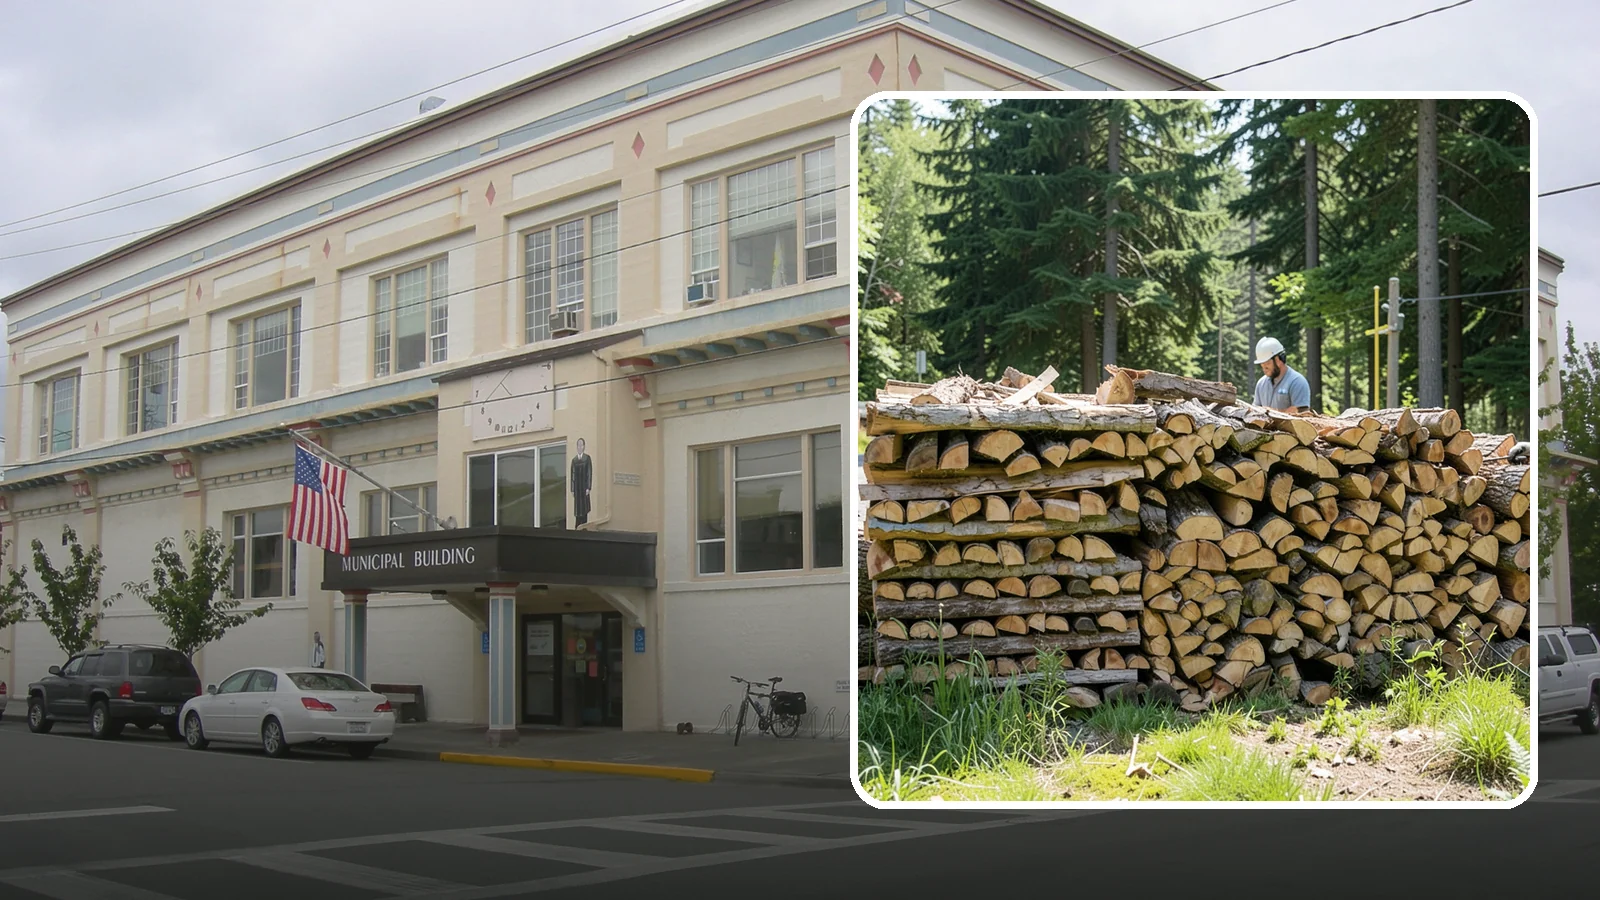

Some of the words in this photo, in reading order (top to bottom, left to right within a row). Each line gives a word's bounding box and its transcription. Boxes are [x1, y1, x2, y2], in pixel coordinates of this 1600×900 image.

[529, 414, 533, 422] 3
[342, 552, 405, 572] MUNICIPAL
[414, 546, 475, 567] BUILDING
